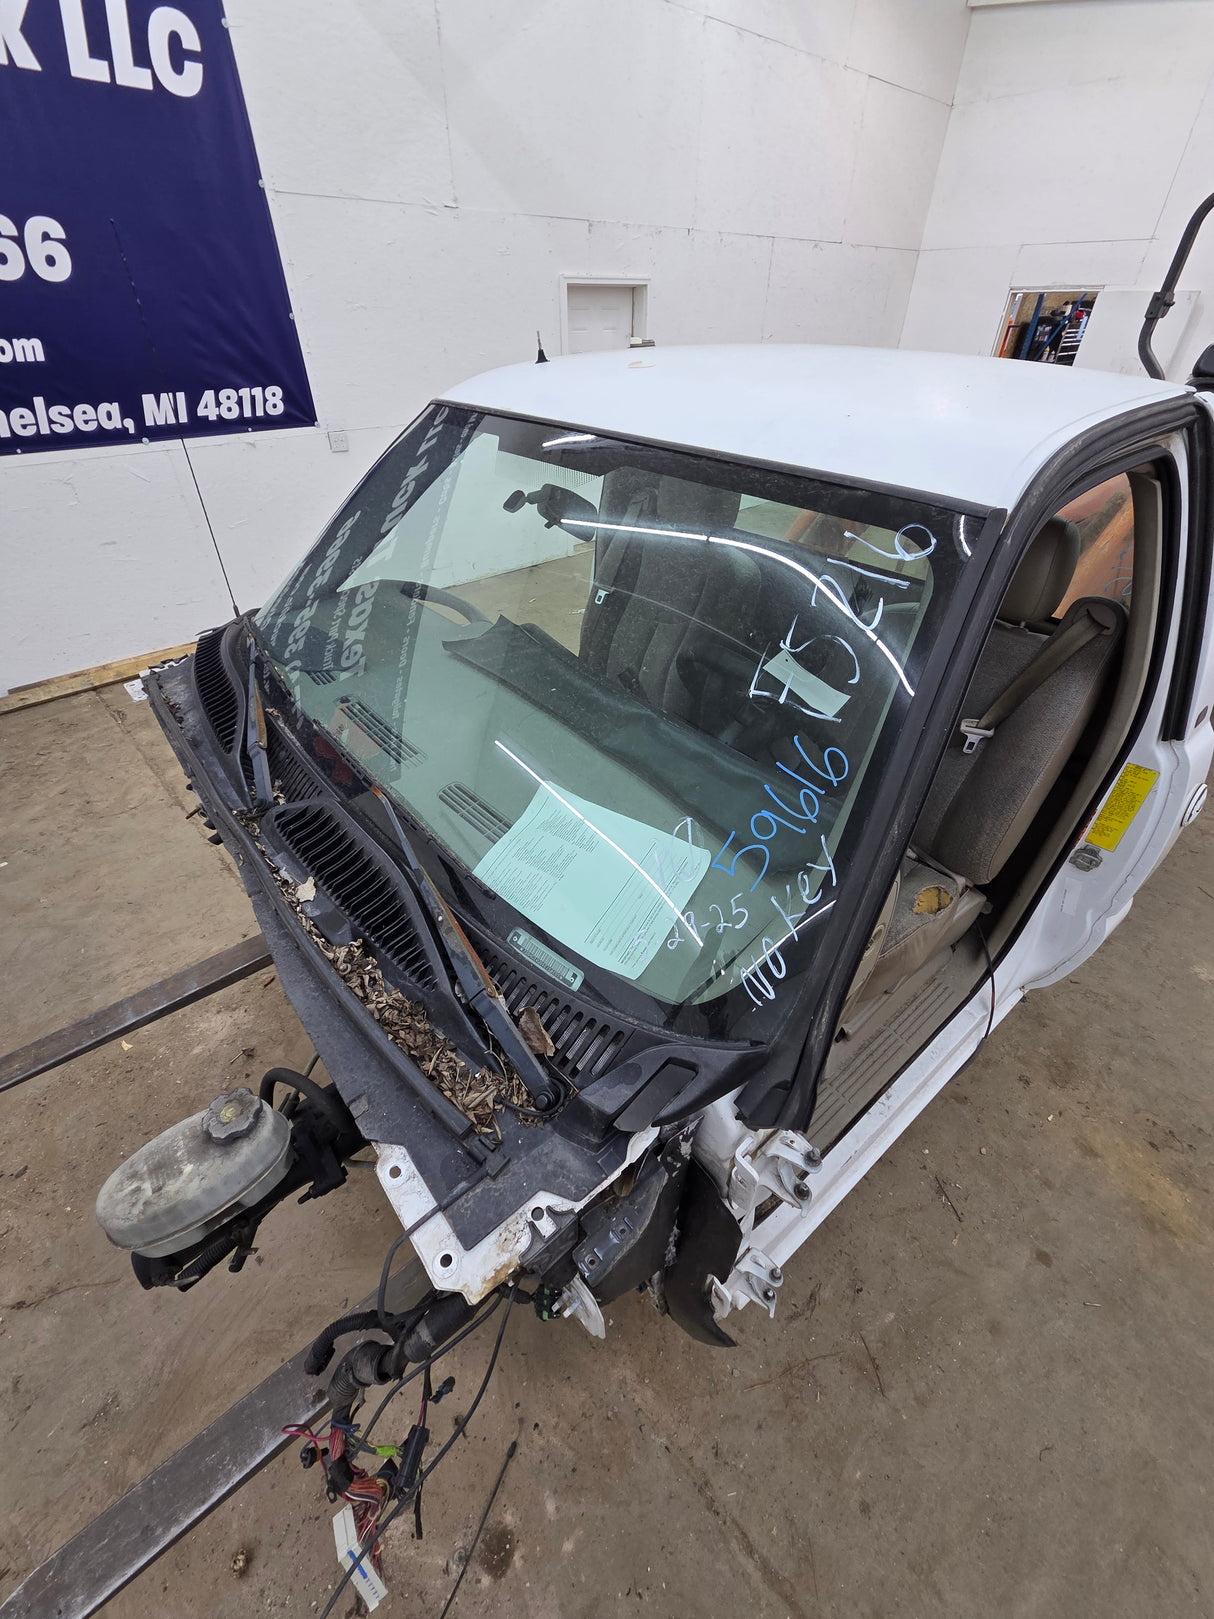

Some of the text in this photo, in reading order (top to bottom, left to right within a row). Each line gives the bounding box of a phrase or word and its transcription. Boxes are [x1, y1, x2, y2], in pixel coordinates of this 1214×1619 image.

[59, 0, 203, 97] LLC
[142, 392, 188, 426] MI
[197, 386, 285, 421] 48118
[711, 734, 849, 892] 59616
